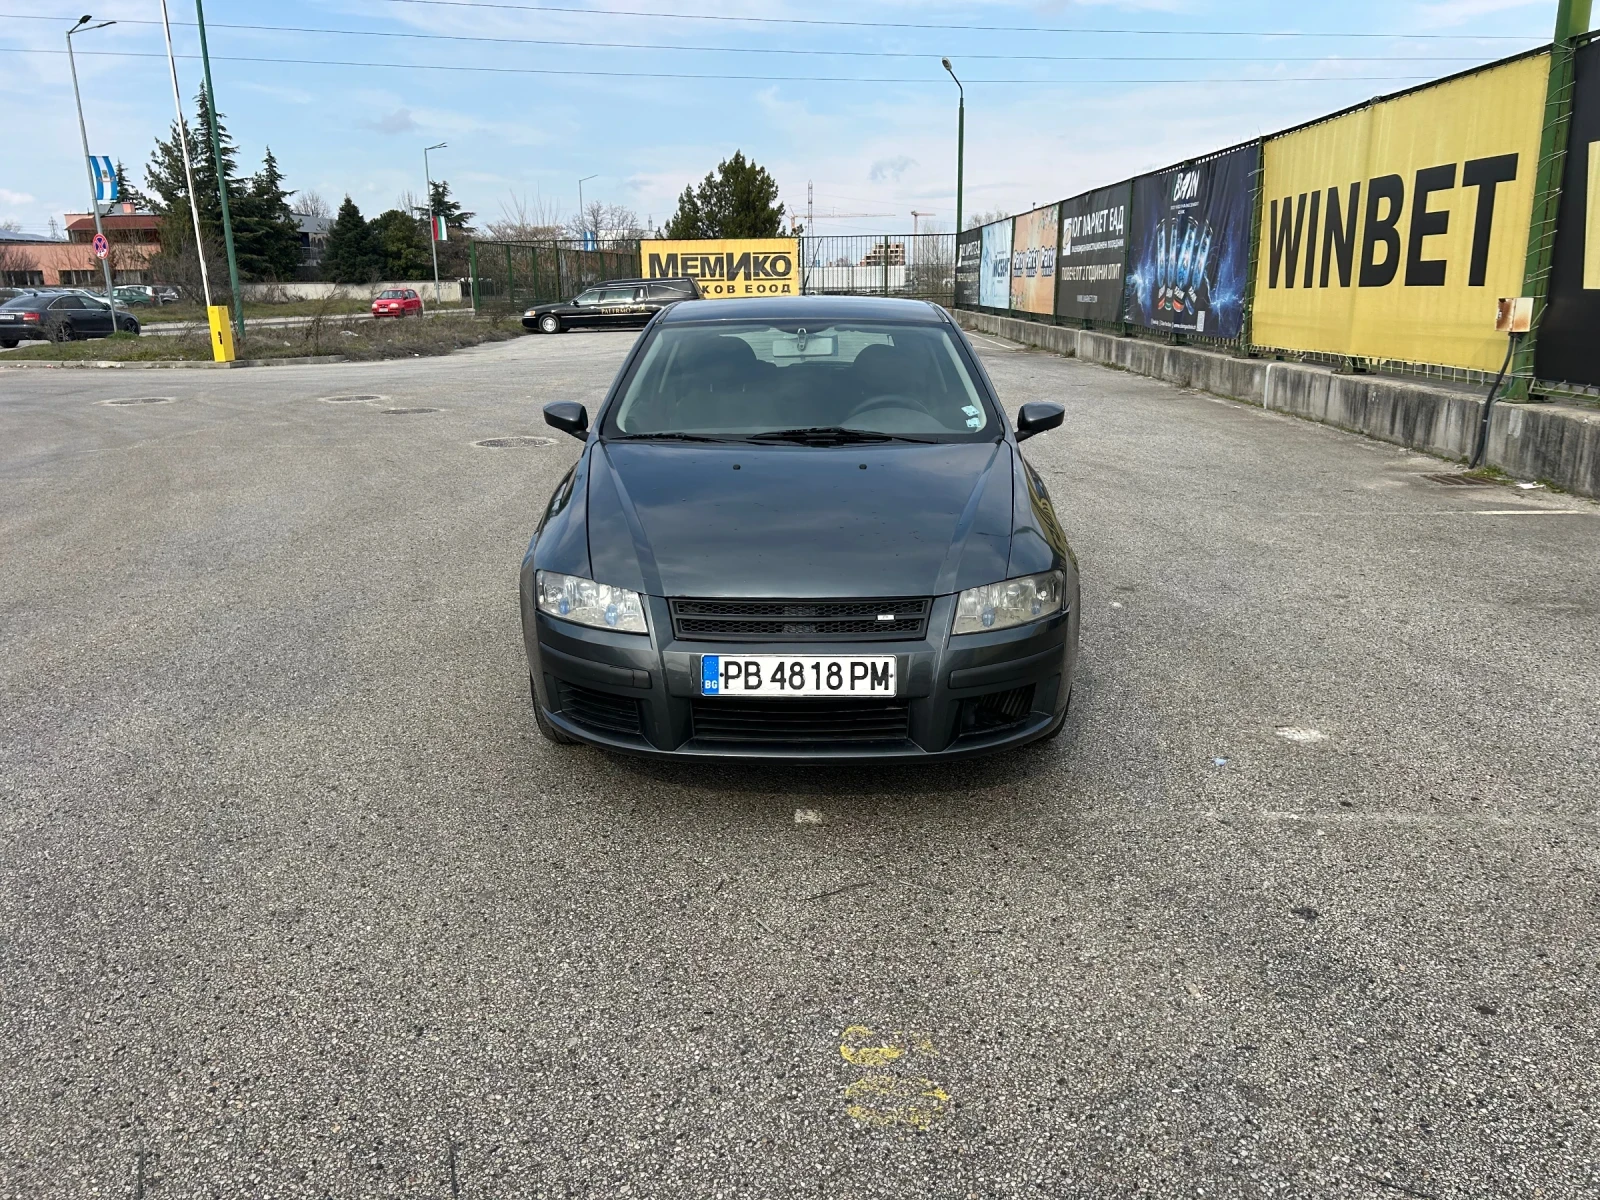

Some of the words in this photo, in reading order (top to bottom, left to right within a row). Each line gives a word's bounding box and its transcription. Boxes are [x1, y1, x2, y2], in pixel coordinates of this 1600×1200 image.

[1083, 209, 1108, 236] МАРКЕТ
[1110, 205, 1124, 235] ЕАД
[1269, 152, 1519, 289] WINBET
[648, 252, 792, 281] МЕМИКО
[701, 284, 736, 294] КОВ
[745, 284, 791, 294] ЕООД
[704, 680, 718, 689] BG
[723, 661, 763, 690] PB
[770, 661, 843, 690] 4818
[850, 661, 890, 690] PM
